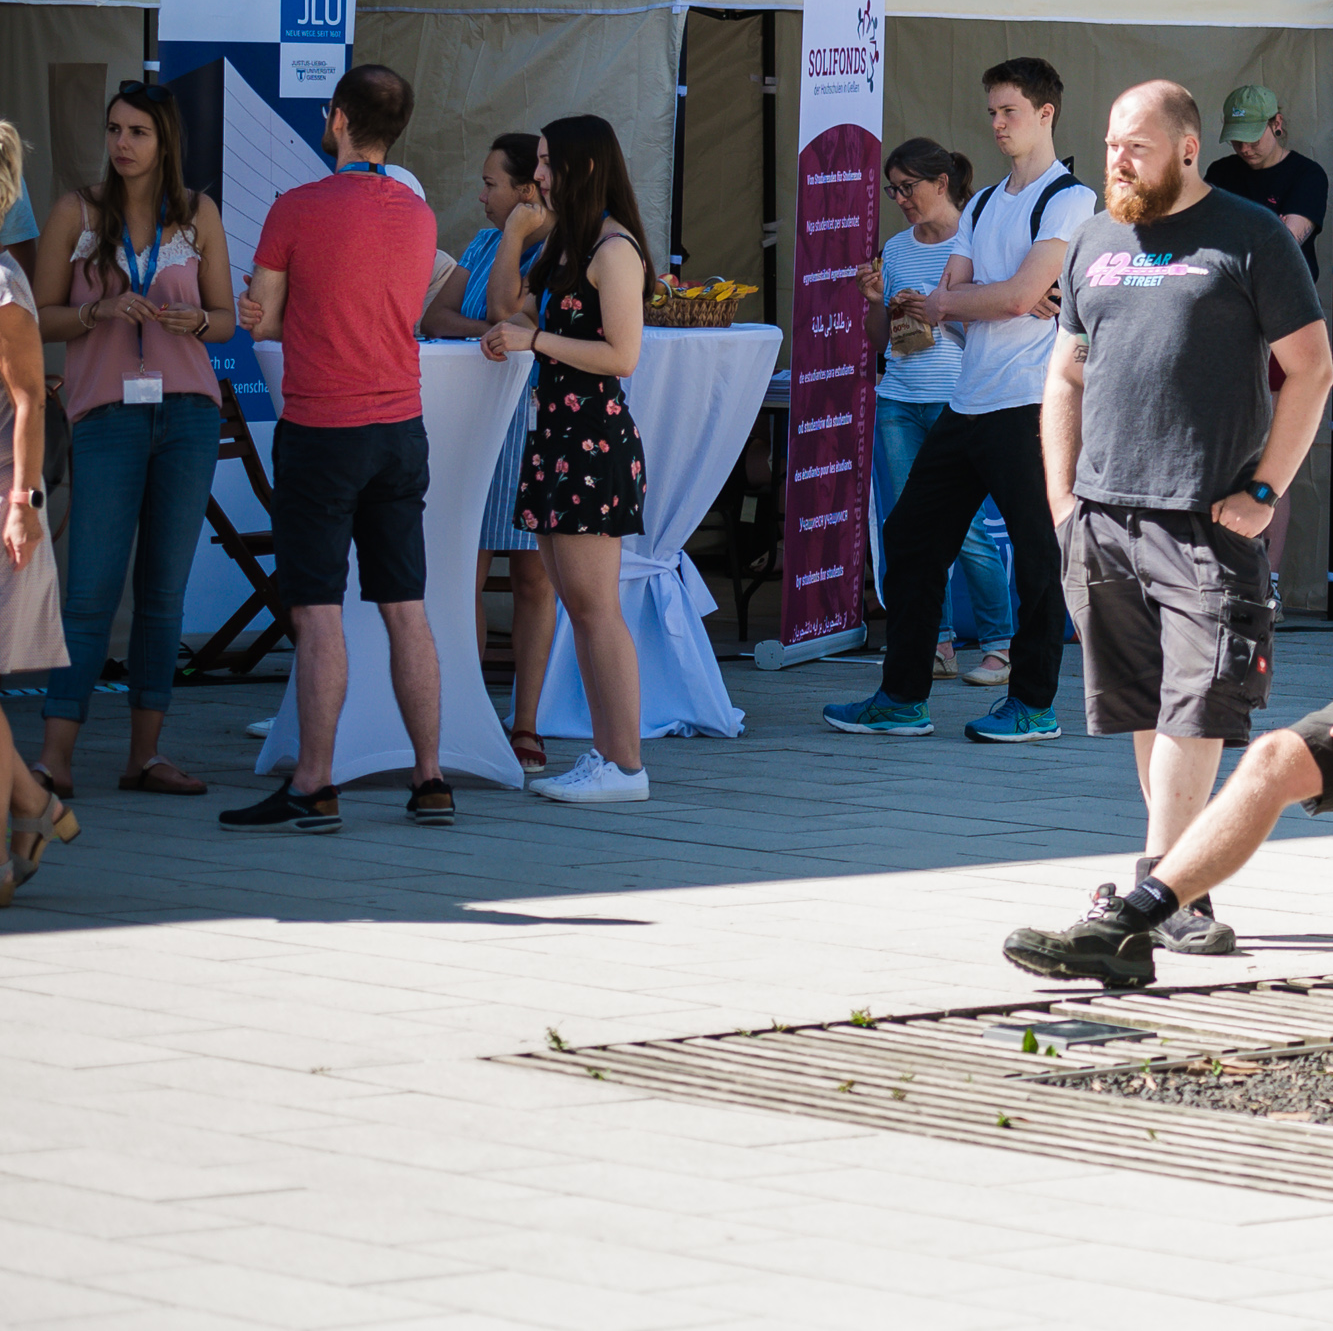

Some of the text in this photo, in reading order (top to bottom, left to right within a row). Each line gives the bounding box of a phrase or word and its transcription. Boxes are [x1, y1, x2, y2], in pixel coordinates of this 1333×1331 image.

[808, 46, 867, 78] SOLIFONDS
[1133, 253, 1172, 266] GEAR
[1086, 252, 1131, 287] 42
[1123, 276, 1164, 287] STREET
[224, 358, 235, 369] 02
